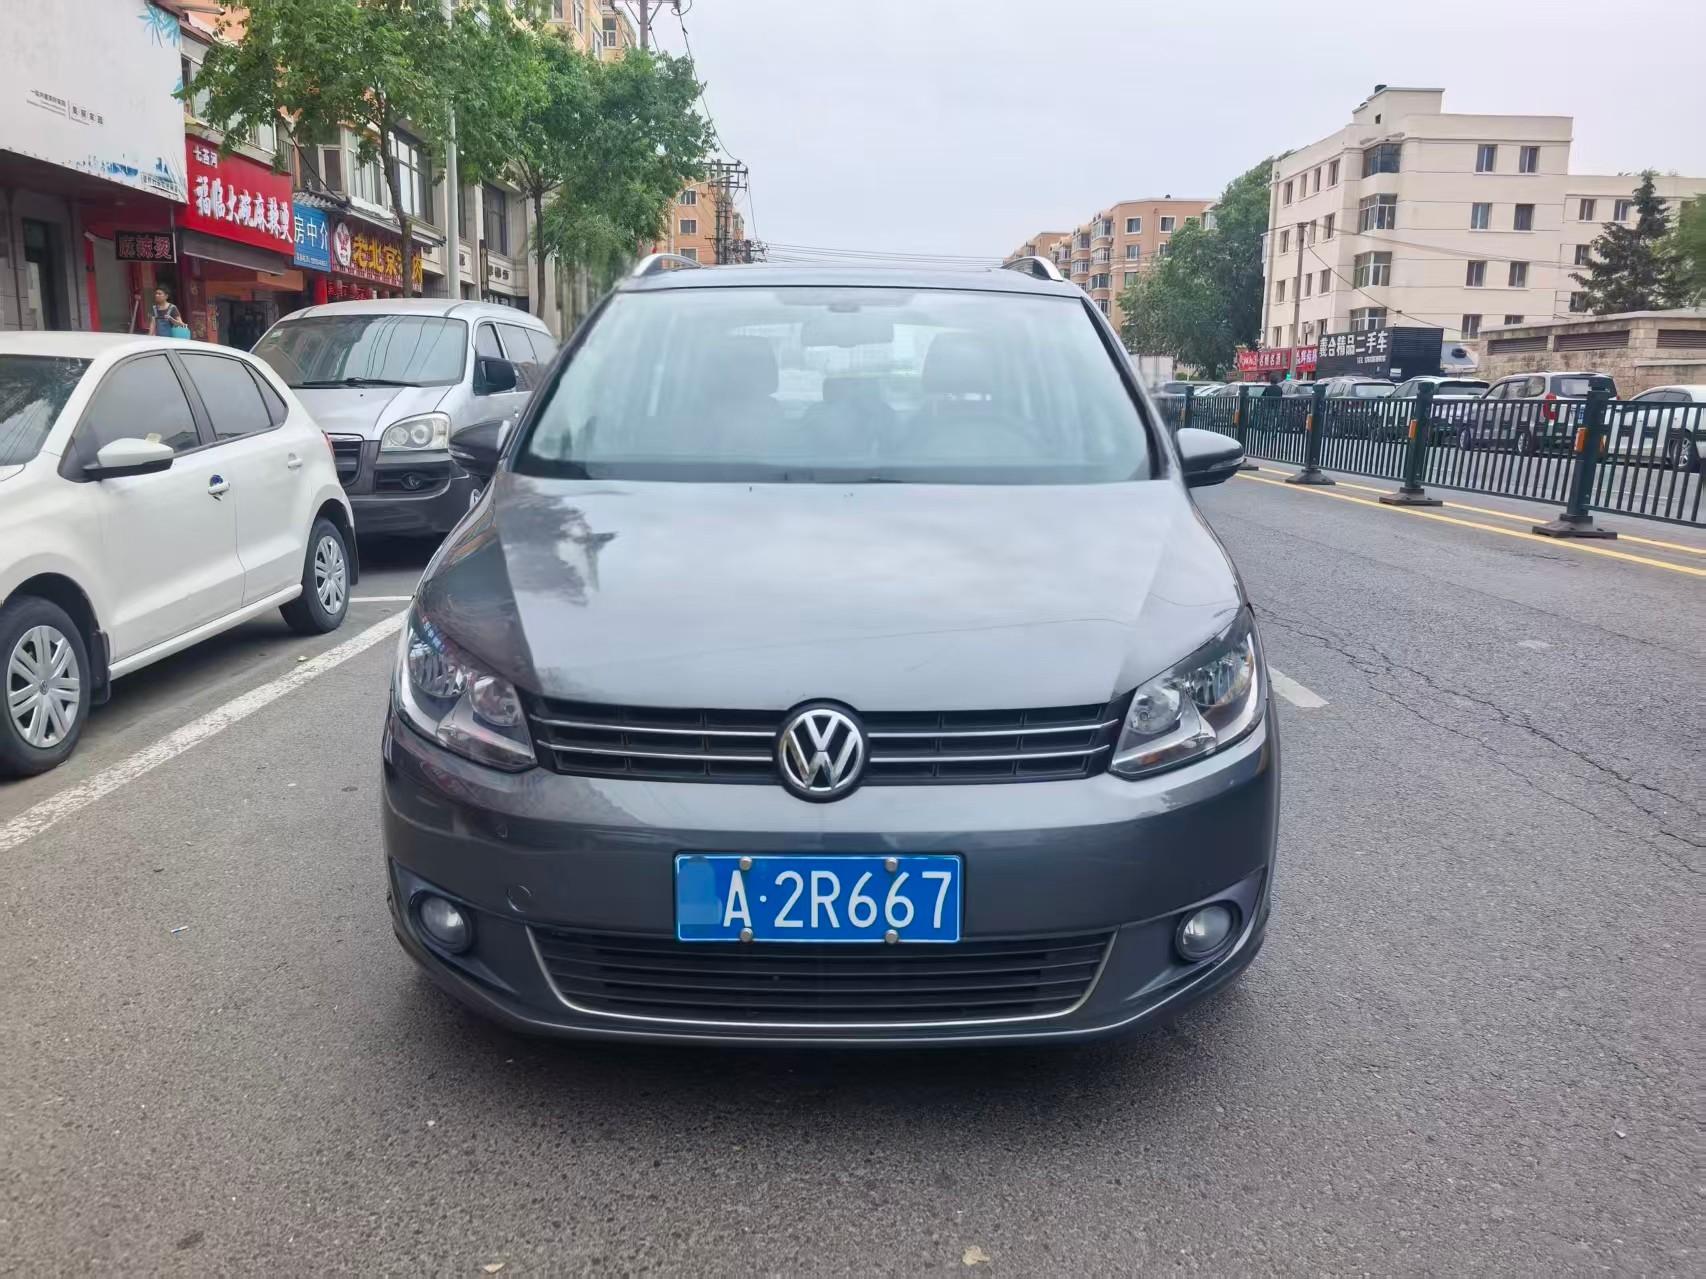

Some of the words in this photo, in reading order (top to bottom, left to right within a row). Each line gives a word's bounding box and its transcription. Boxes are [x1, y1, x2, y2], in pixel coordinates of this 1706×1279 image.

[193, 175, 293, 244] 福临大碗麻辣烫
